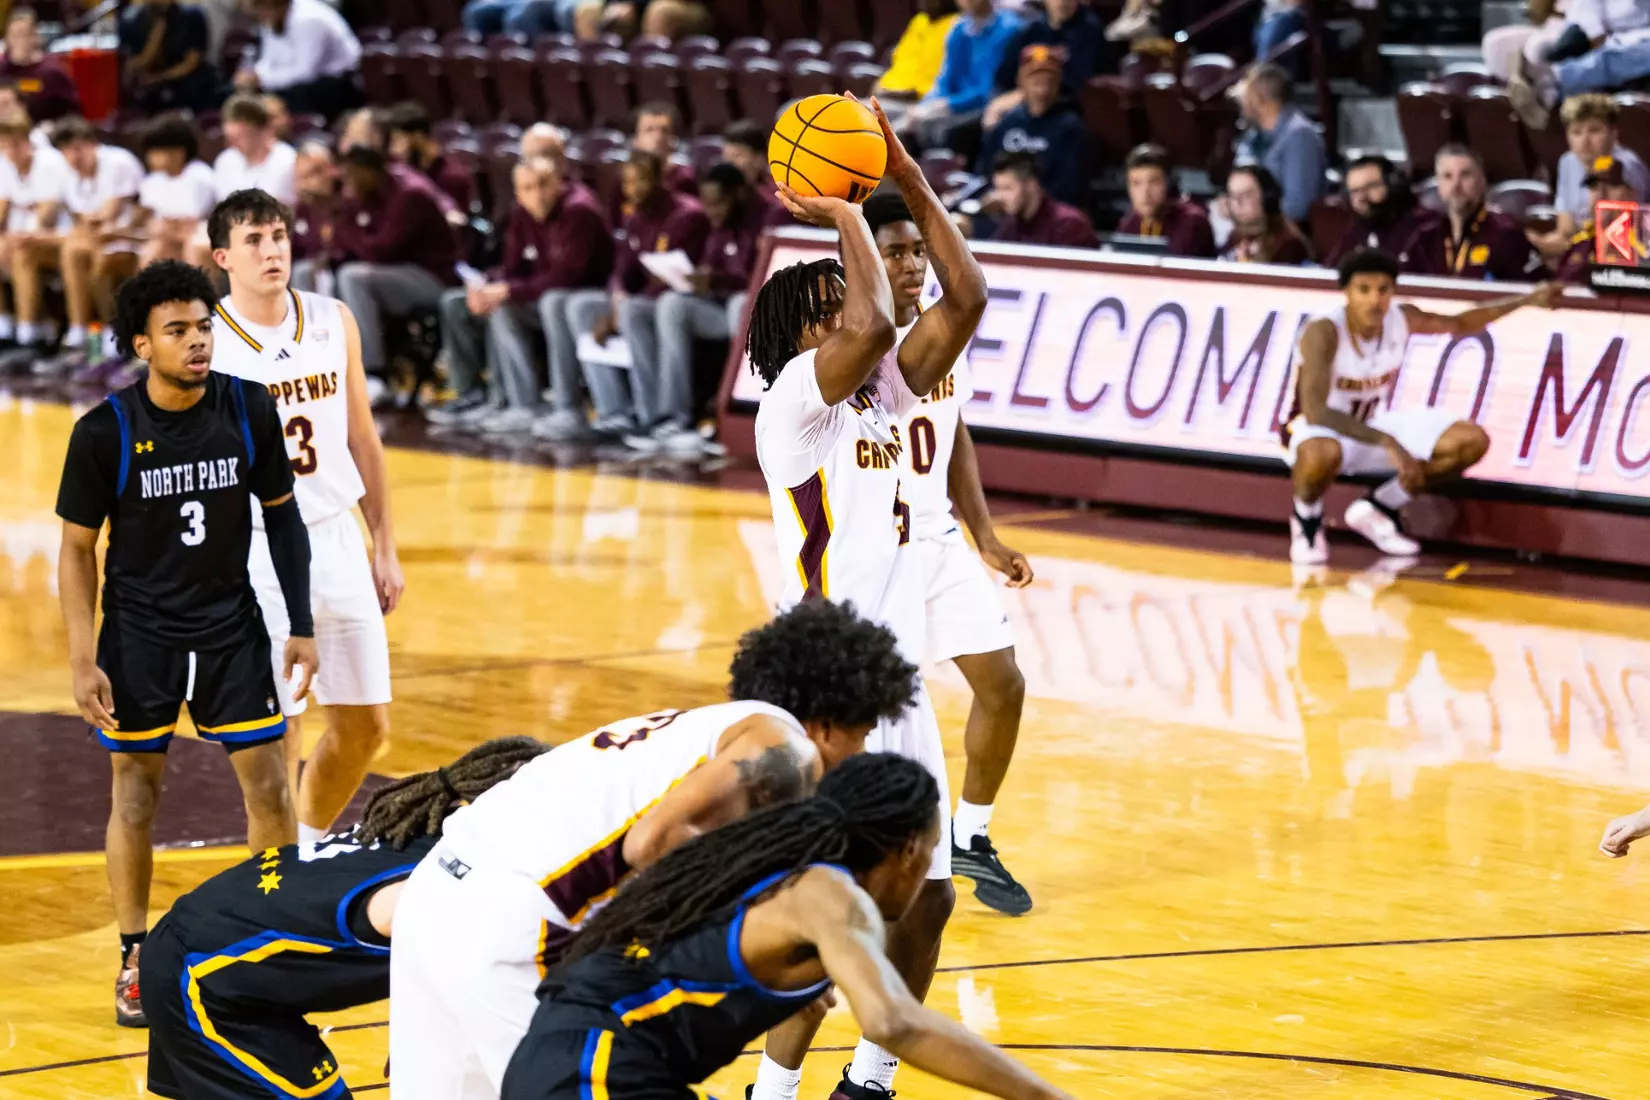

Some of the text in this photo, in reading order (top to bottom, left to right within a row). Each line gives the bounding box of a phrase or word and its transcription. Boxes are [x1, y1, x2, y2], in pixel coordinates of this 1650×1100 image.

[284, 415, 318, 476] 3
[908, 415, 937, 476] 0
[140, 457, 239, 499] NORTH PARK
[180, 501, 206, 546] 3
